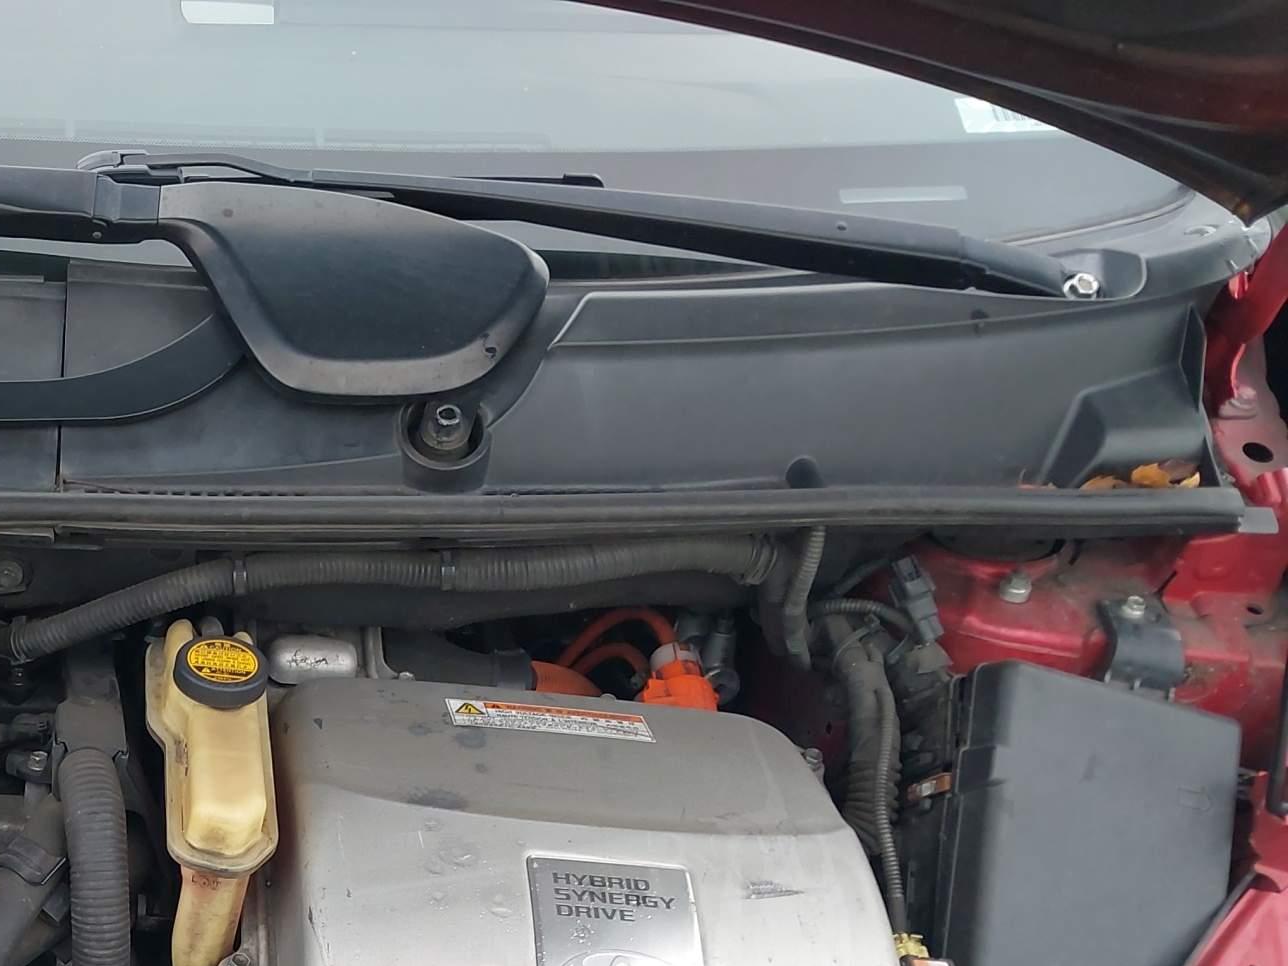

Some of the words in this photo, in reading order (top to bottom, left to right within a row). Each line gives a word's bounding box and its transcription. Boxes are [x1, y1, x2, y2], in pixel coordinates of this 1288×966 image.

[551, 872, 650, 891] HYBRID
[553, 888, 675, 909] SYNERGY
[555, 904, 636, 922] DRIVE
